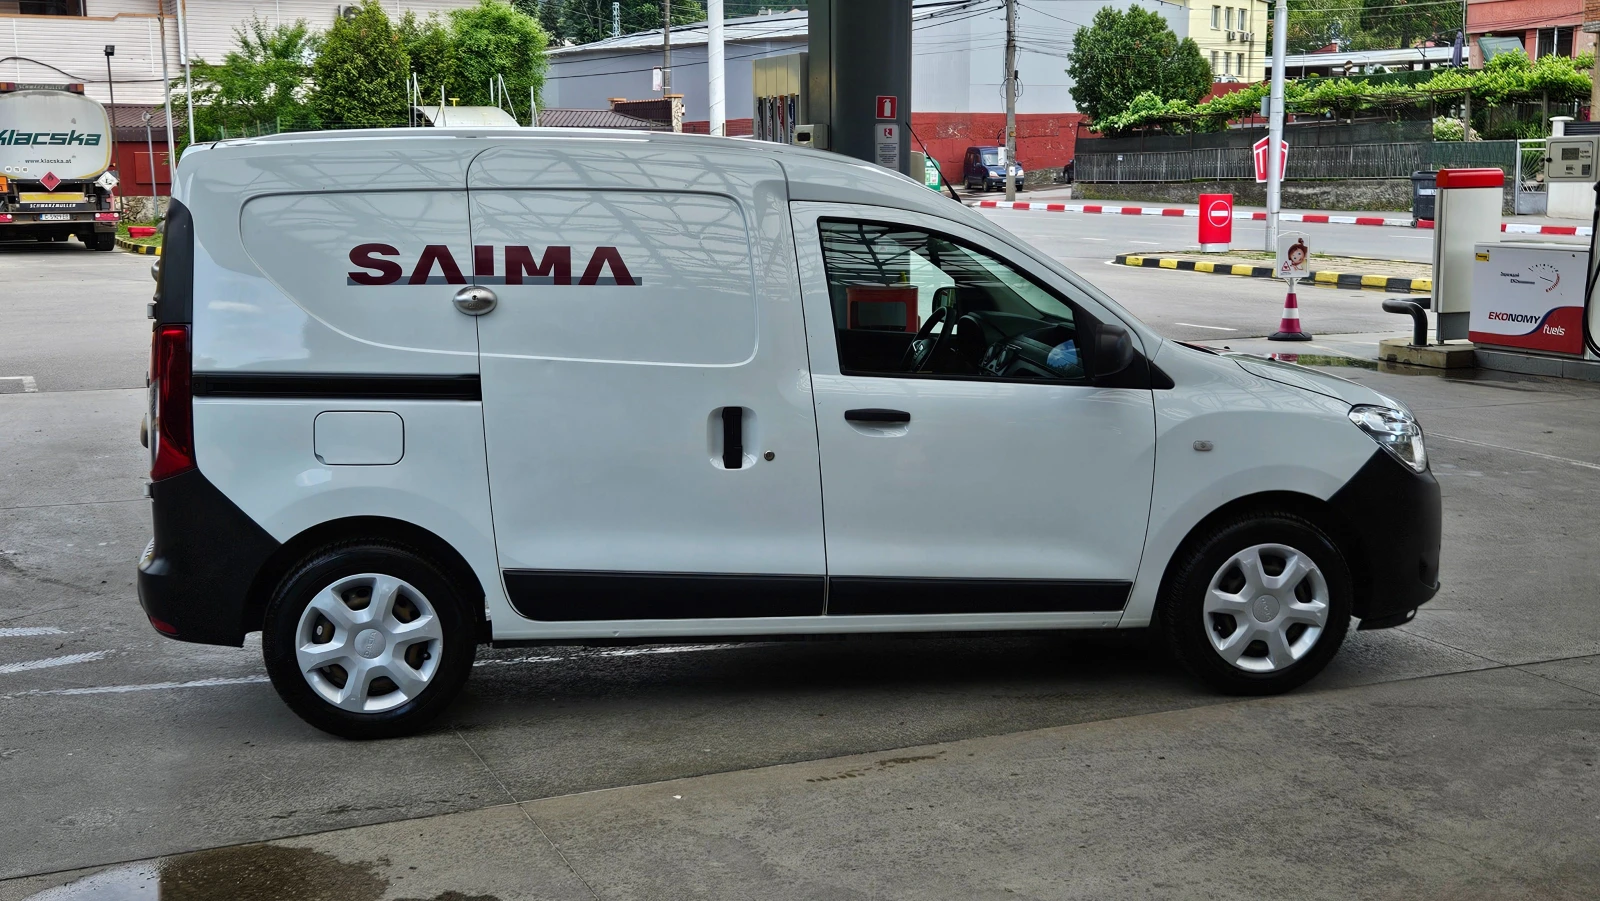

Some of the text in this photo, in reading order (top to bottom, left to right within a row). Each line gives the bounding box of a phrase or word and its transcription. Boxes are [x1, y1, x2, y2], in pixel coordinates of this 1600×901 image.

[347, 243, 637, 285] SAIMA
[1488, 312, 1566, 336] EKONOMY fuels
